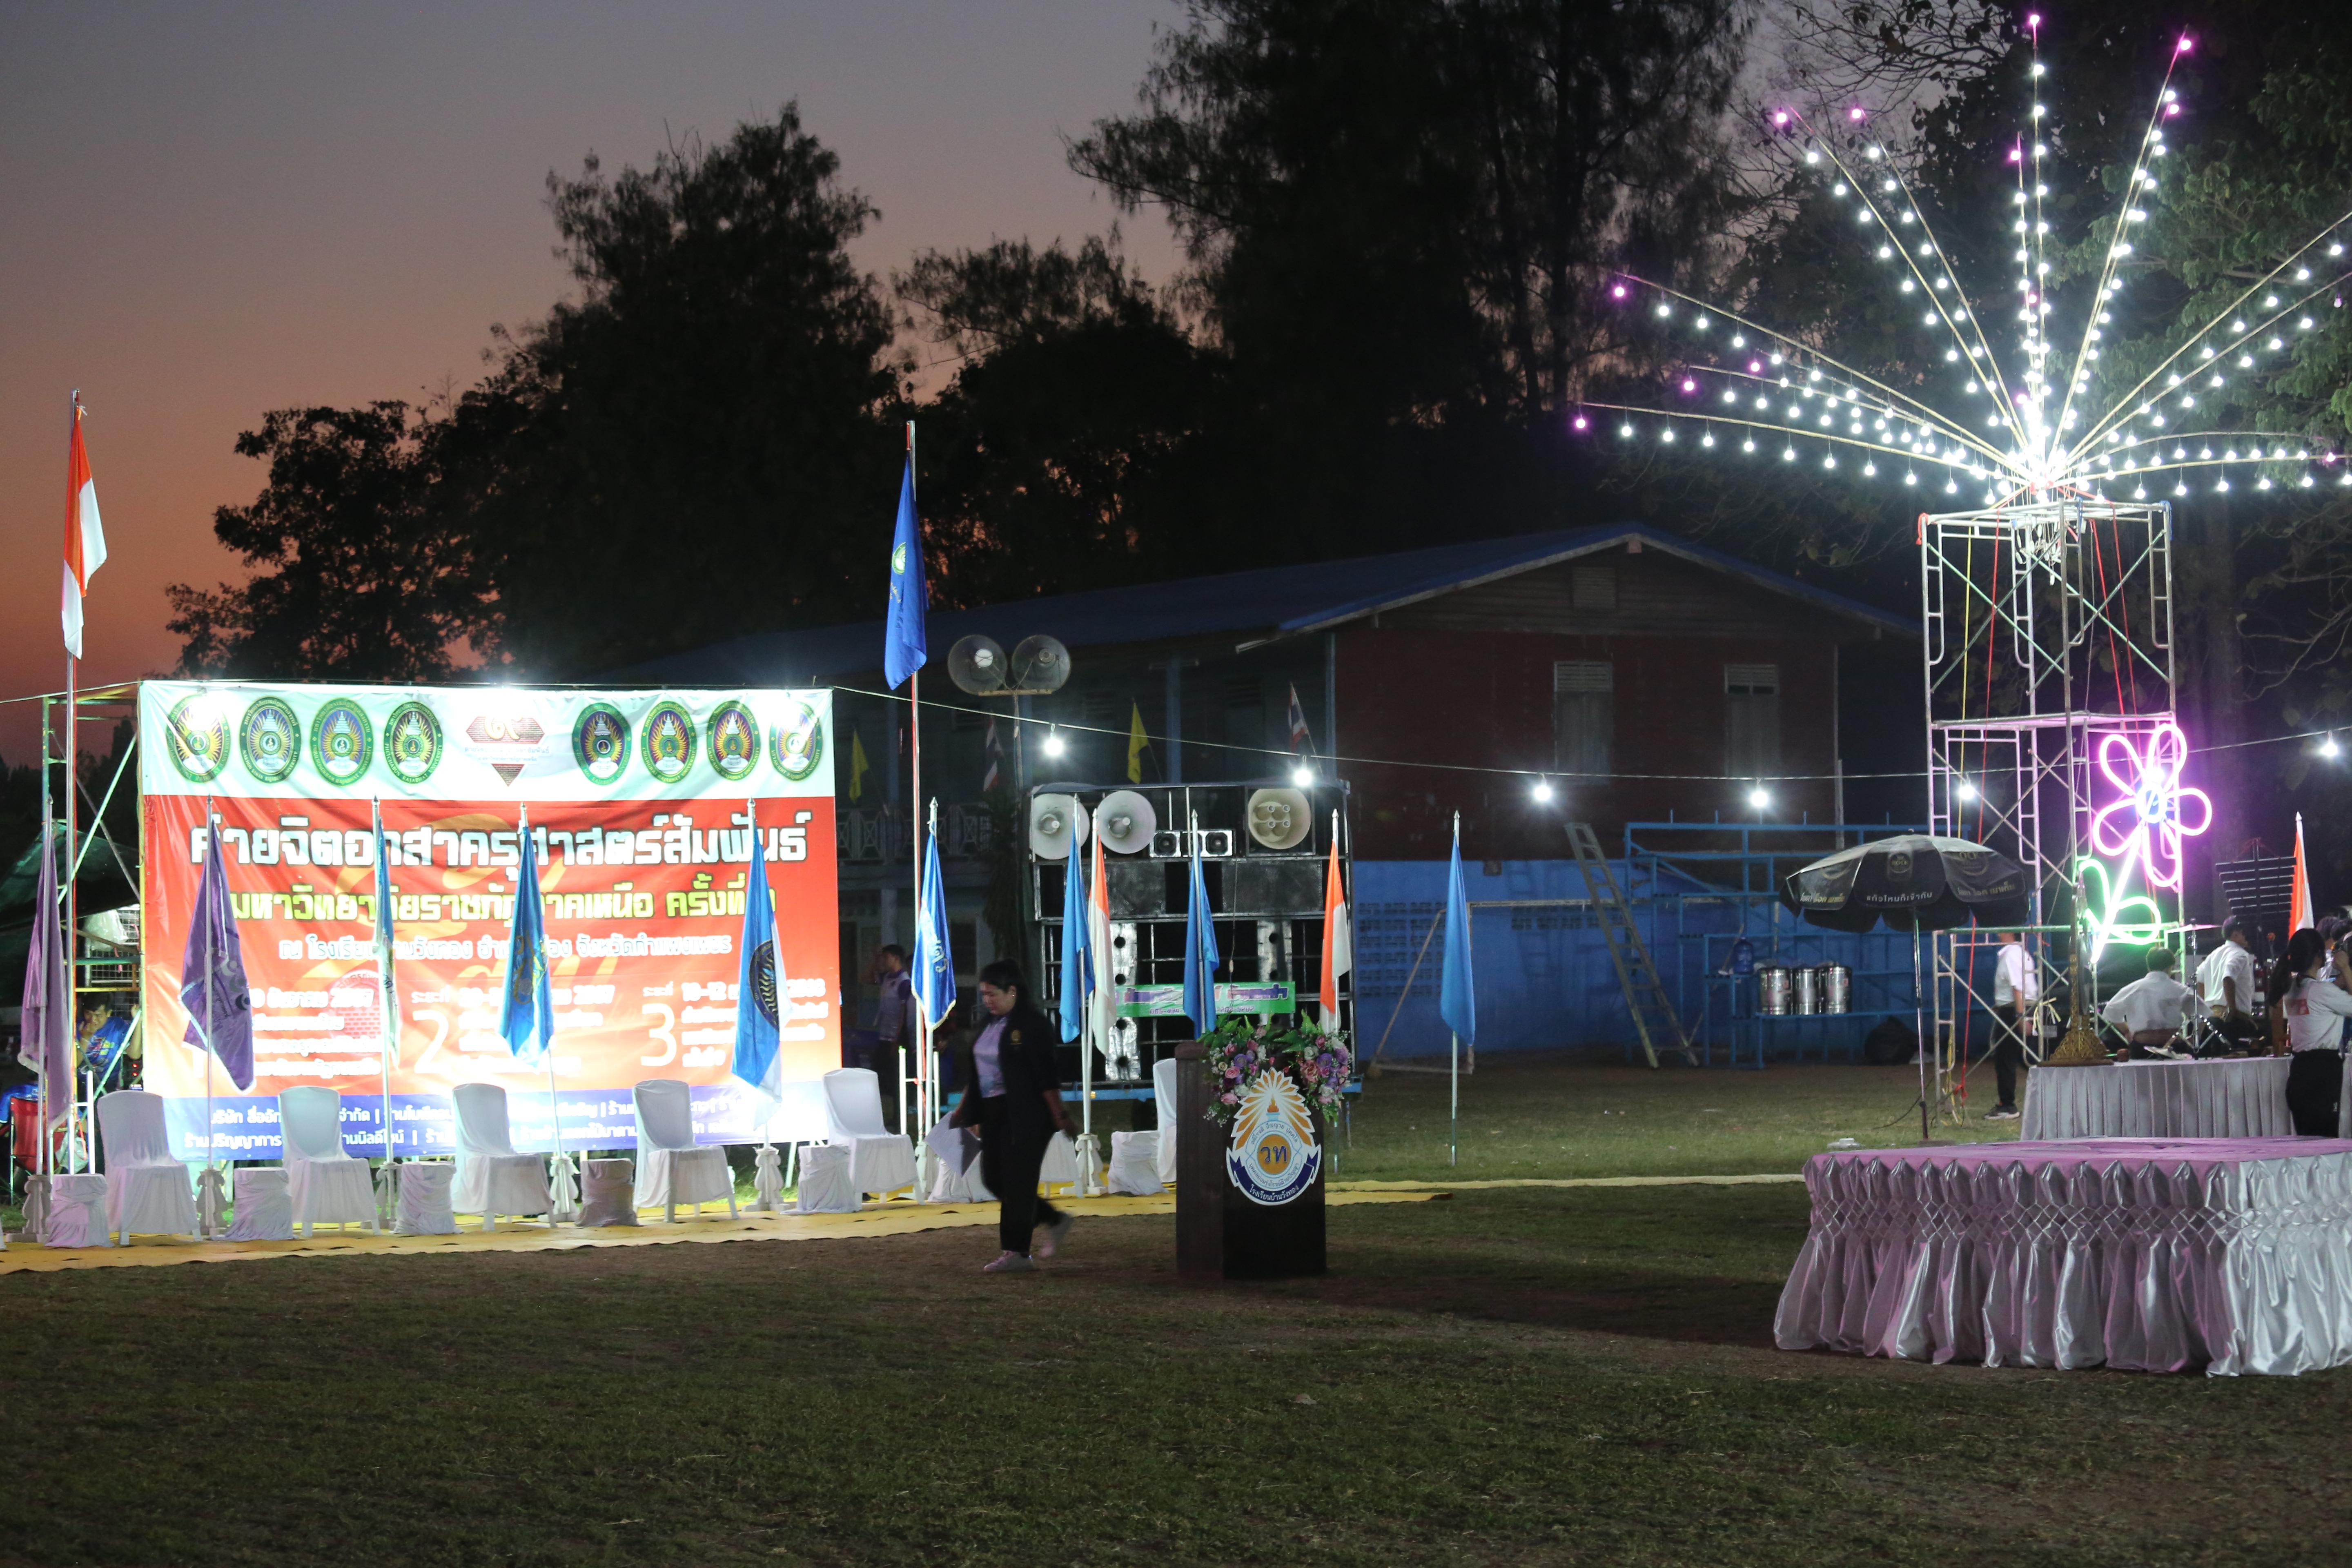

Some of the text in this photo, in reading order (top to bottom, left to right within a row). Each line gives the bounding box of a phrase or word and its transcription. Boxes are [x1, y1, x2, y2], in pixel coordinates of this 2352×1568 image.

[229, 882, 654, 928] มหาวิทยาัยราชภัฏาคเหนือ
[305, 933, 472, 960] โรงเรียนานวังทอง
[412, 1009, 450, 1074] 2
[641, 1003, 677, 1067] 3
[1260, 1145, 1287, 1163] วท
[1249, 1183, 1299, 1201] โรงเรียนบ้านวังทอง
